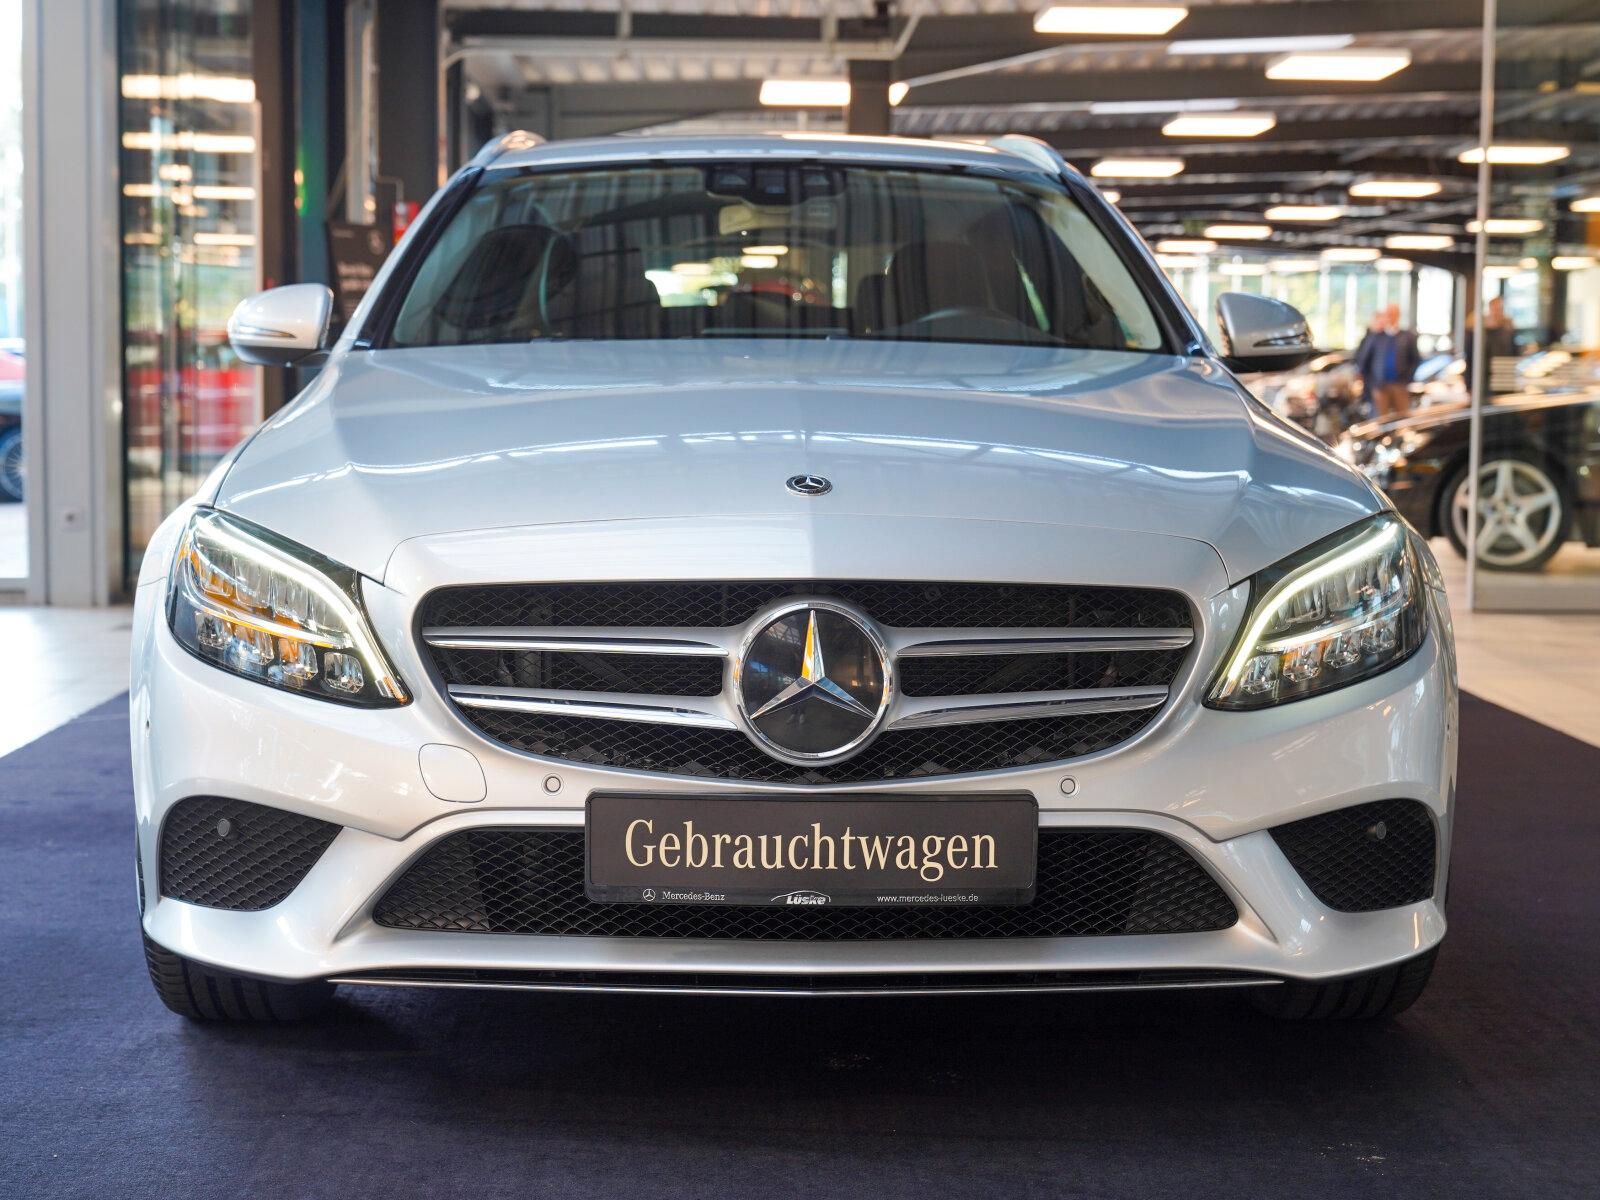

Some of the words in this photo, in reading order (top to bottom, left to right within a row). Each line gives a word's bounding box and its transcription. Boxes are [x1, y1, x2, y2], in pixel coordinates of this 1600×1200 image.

[624, 818, 998, 883] Gebrauchtwagen
[662, 891, 726, 901] Mercedes-Benz
[876, 893, 979, 903] www.mercedes-lueske.de
